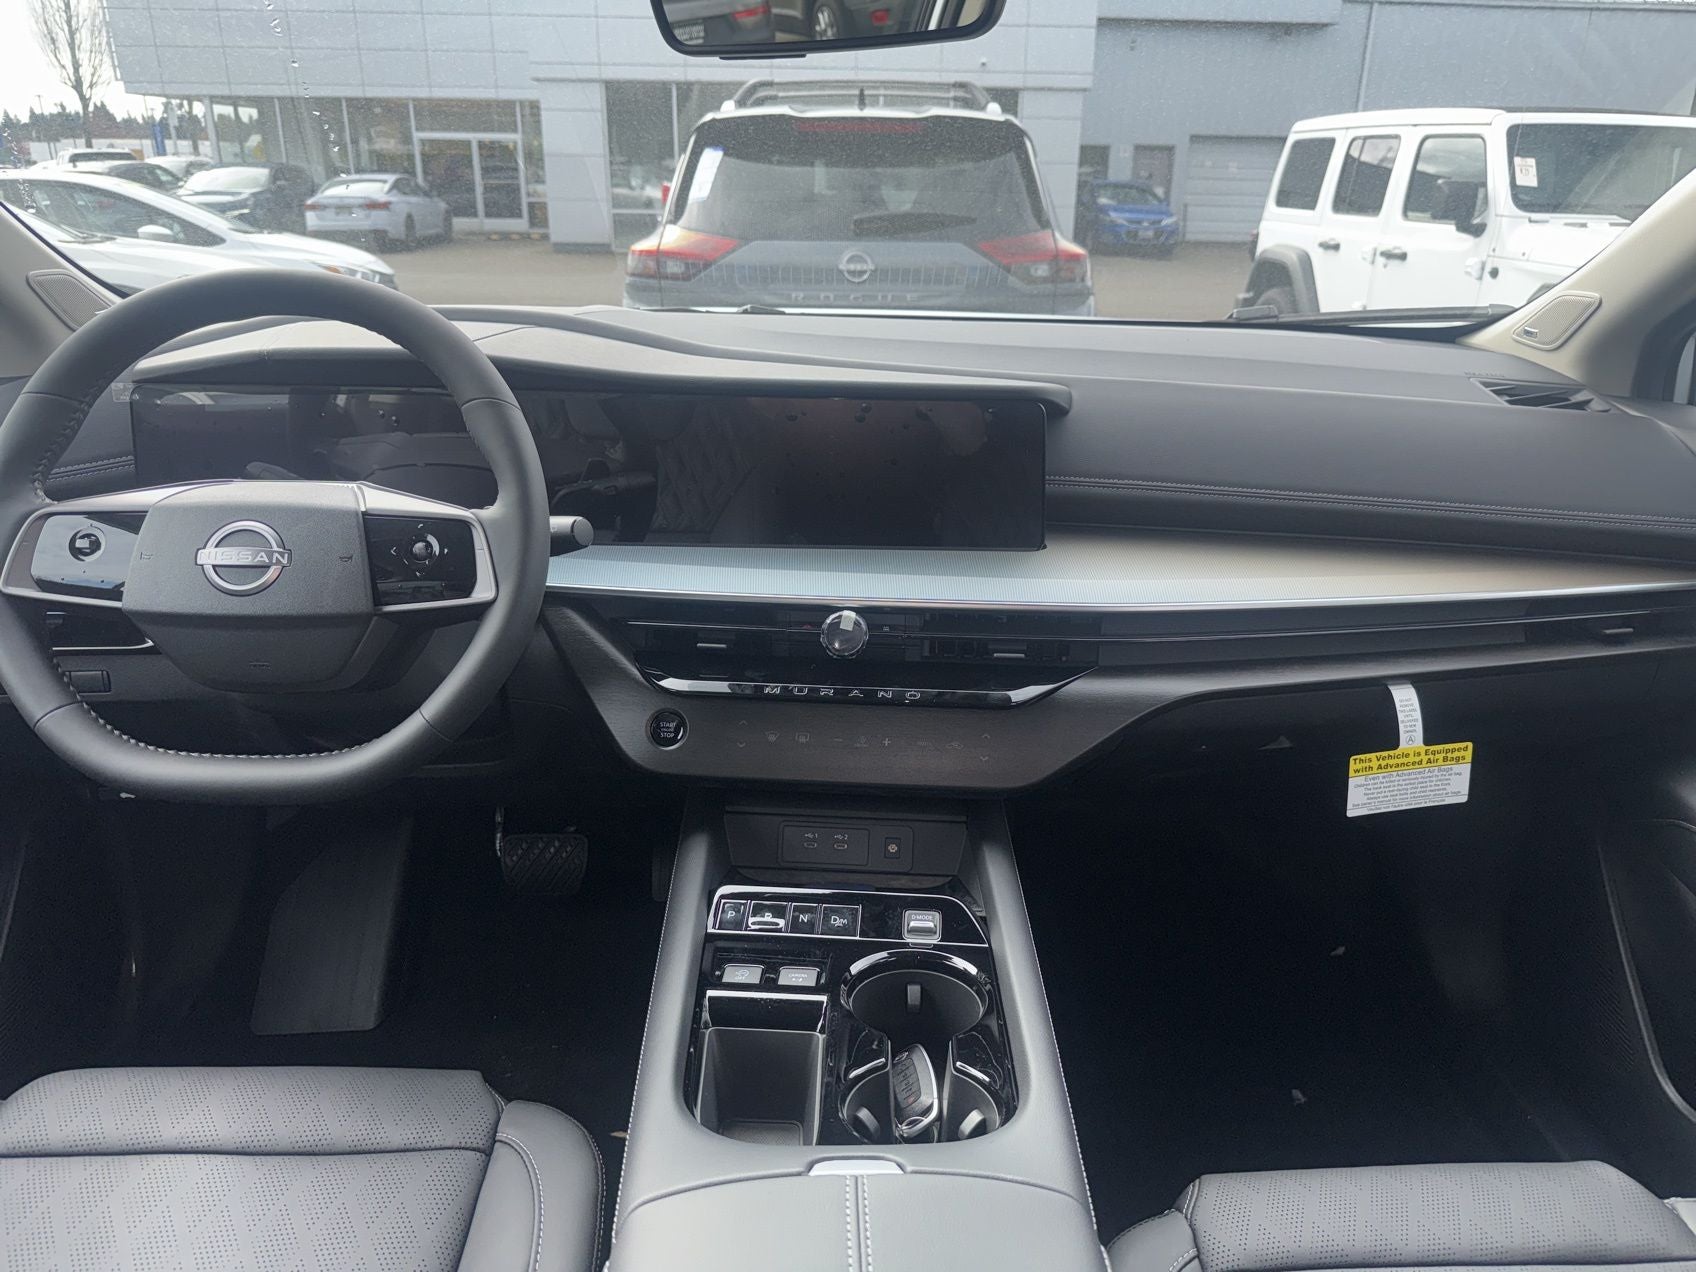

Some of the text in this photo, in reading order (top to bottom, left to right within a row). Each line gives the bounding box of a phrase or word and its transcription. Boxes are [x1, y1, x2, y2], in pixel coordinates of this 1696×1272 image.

[200, 551, 289, 564] NISSAN
[763, 686, 921, 700] MURANO
[1376, 752, 1410, 762] Vehicle
[1424, 745, 1468, 756] Equipped
[1353, 755, 1466, 774] with Advanced Air Bags
[1395, 769, 1426, 777] Advanced
[1437, 766, 1453, 774] Bags
[727, 910, 735, 919] P
[799, 914, 808, 923] N
